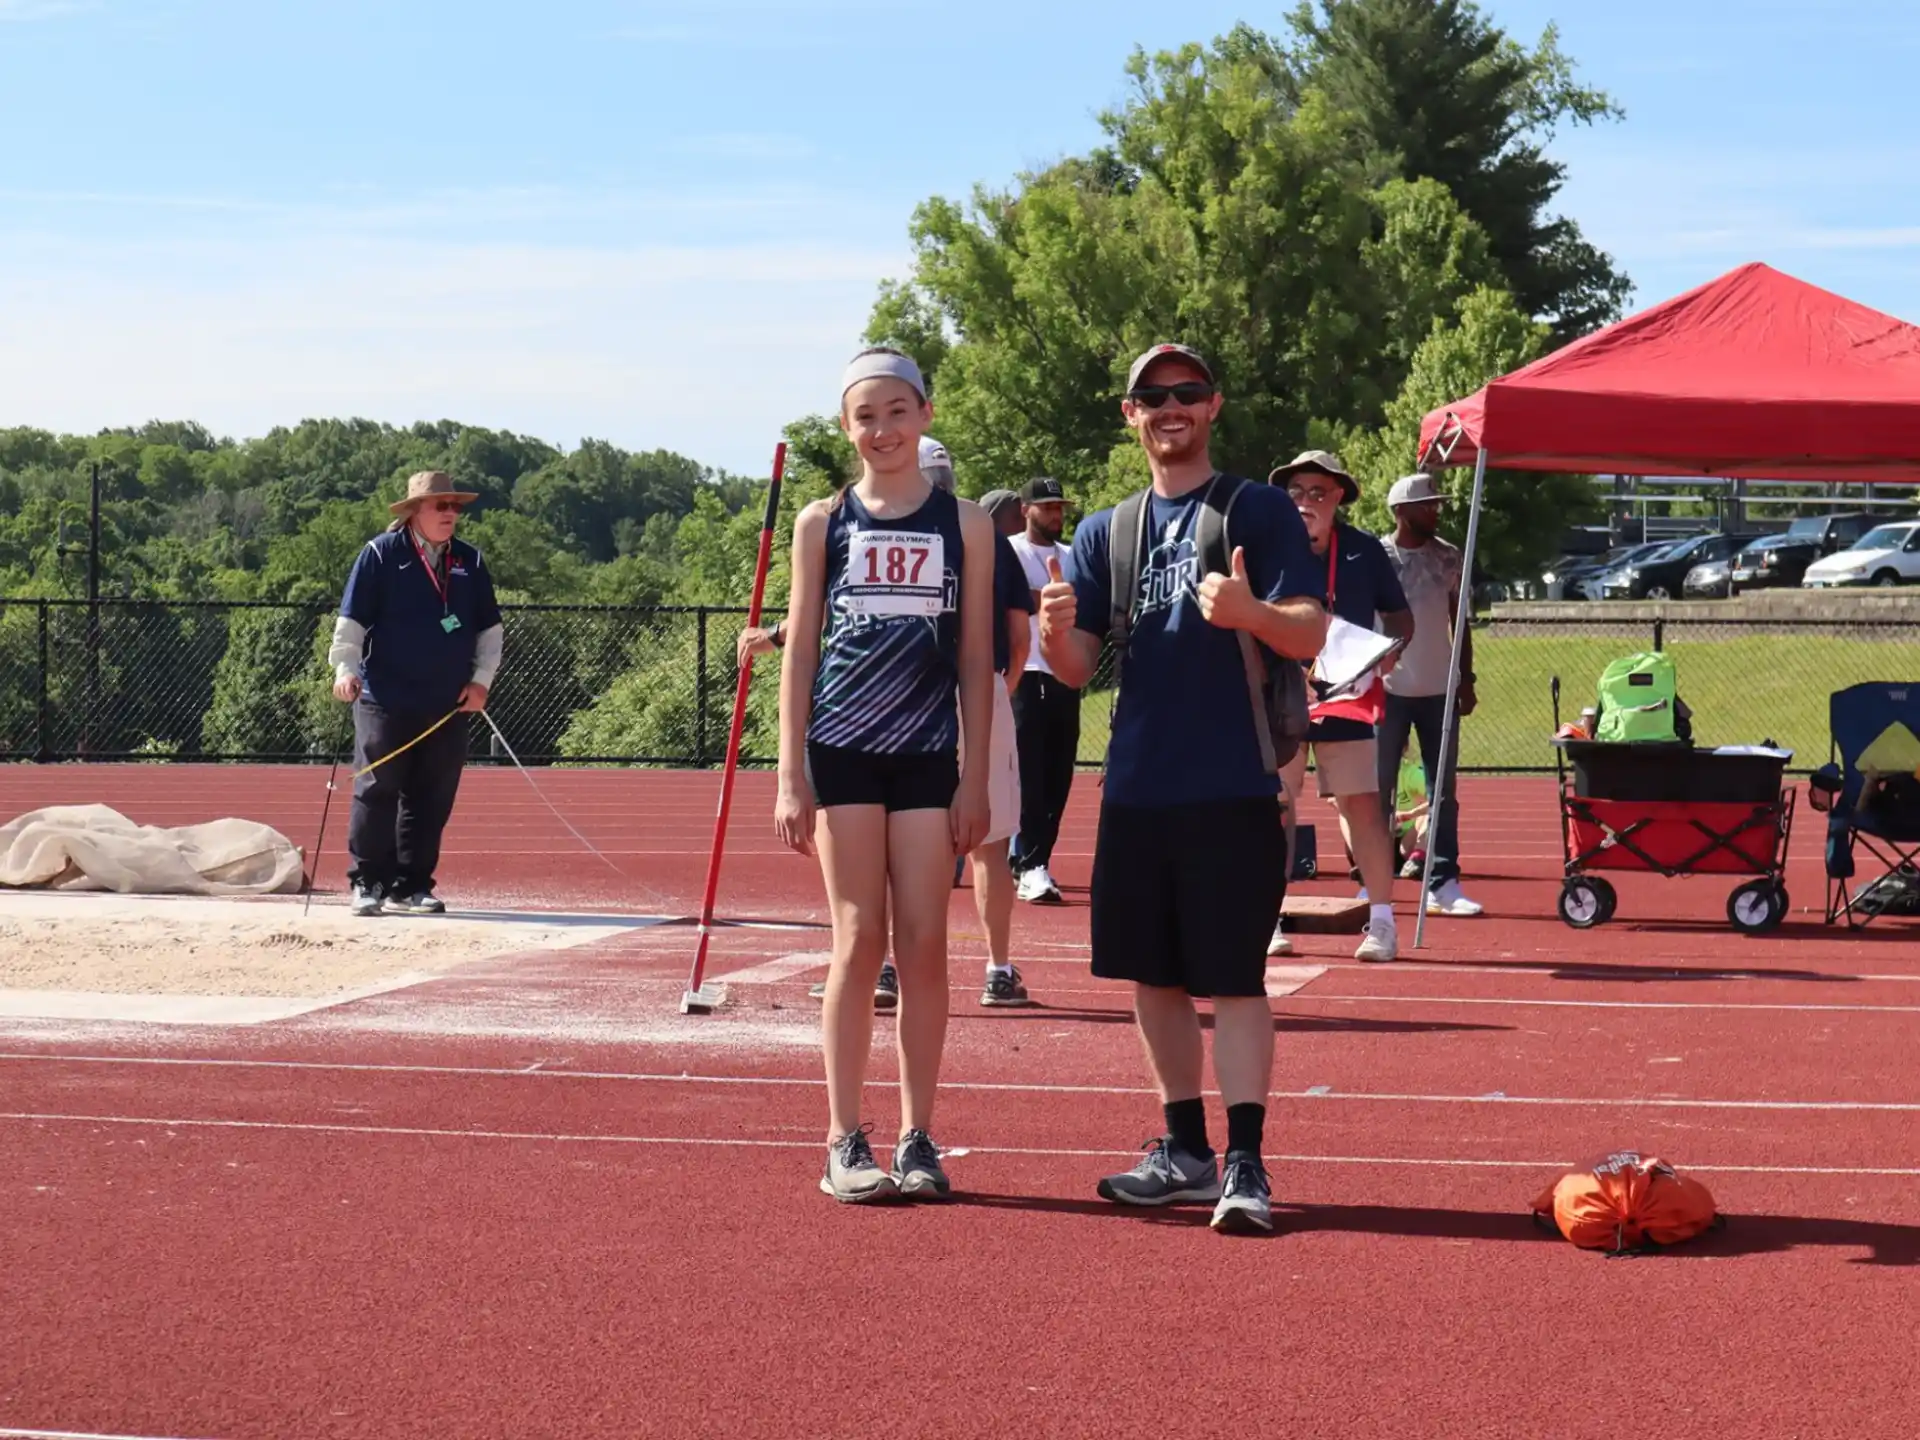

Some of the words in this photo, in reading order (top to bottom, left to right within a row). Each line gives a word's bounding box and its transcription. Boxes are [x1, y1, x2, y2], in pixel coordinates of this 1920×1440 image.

[861, 535, 893, 543] JUNIOR
[895, 536, 932, 544] OLYMPIC
[864, 547, 929, 584] 187
